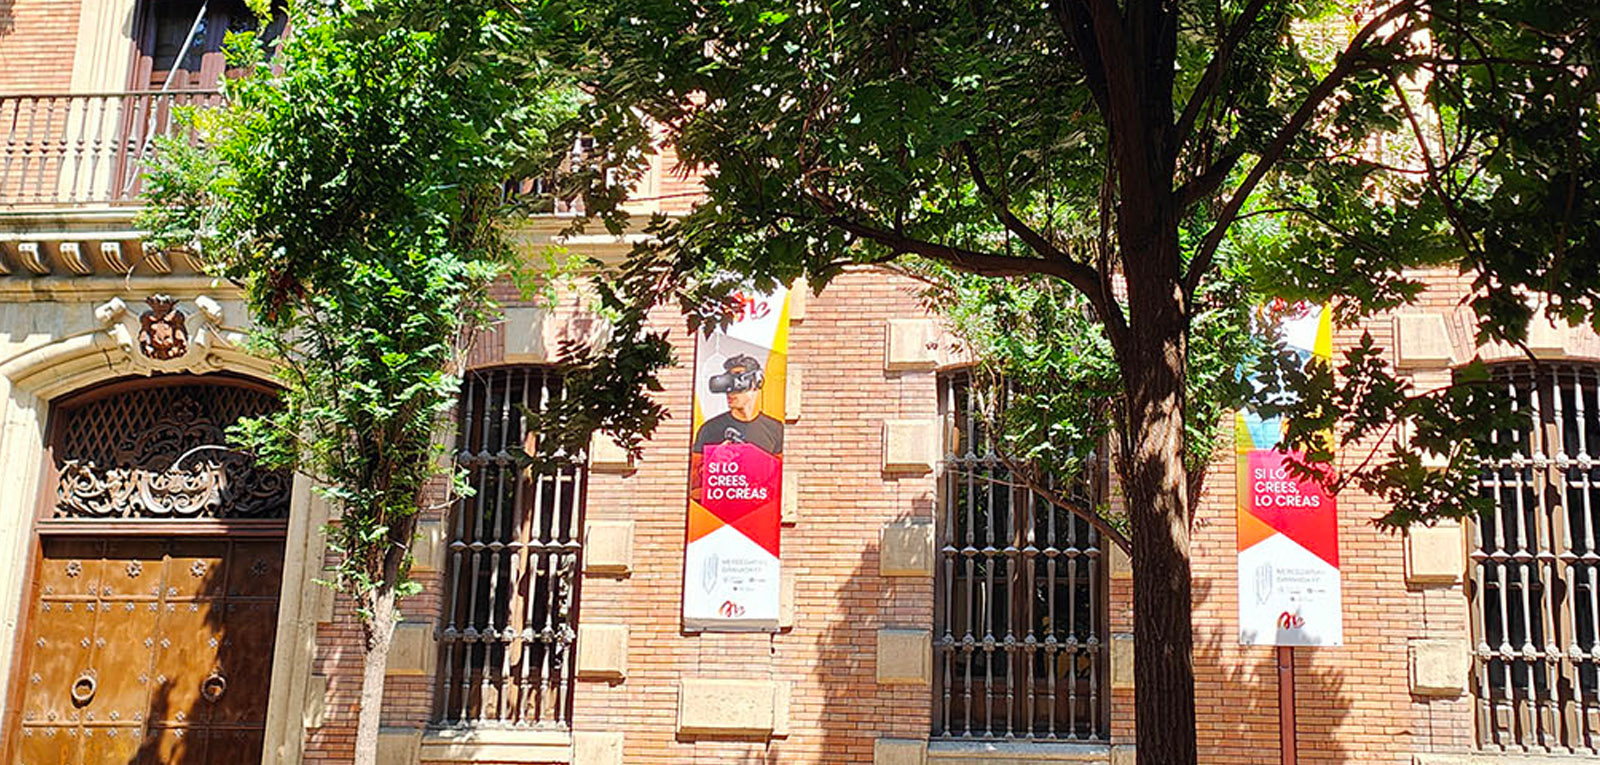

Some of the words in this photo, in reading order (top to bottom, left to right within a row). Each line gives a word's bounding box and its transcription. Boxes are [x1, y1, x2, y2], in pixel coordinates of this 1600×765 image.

[708, 461, 720, 474] SI
[722, 461, 739, 474] LO
[1255, 468, 1266, 480] SI
[1269, 468, 1287, 480] LO
[707, 474, 749, 489] CREES,
[1254, 481, 1300, 495] CREES,
[707, 487, 724, 500] LO
[1255, 494, 1273, 507] LO
[1275, 494, 1320, 507] CREAS
